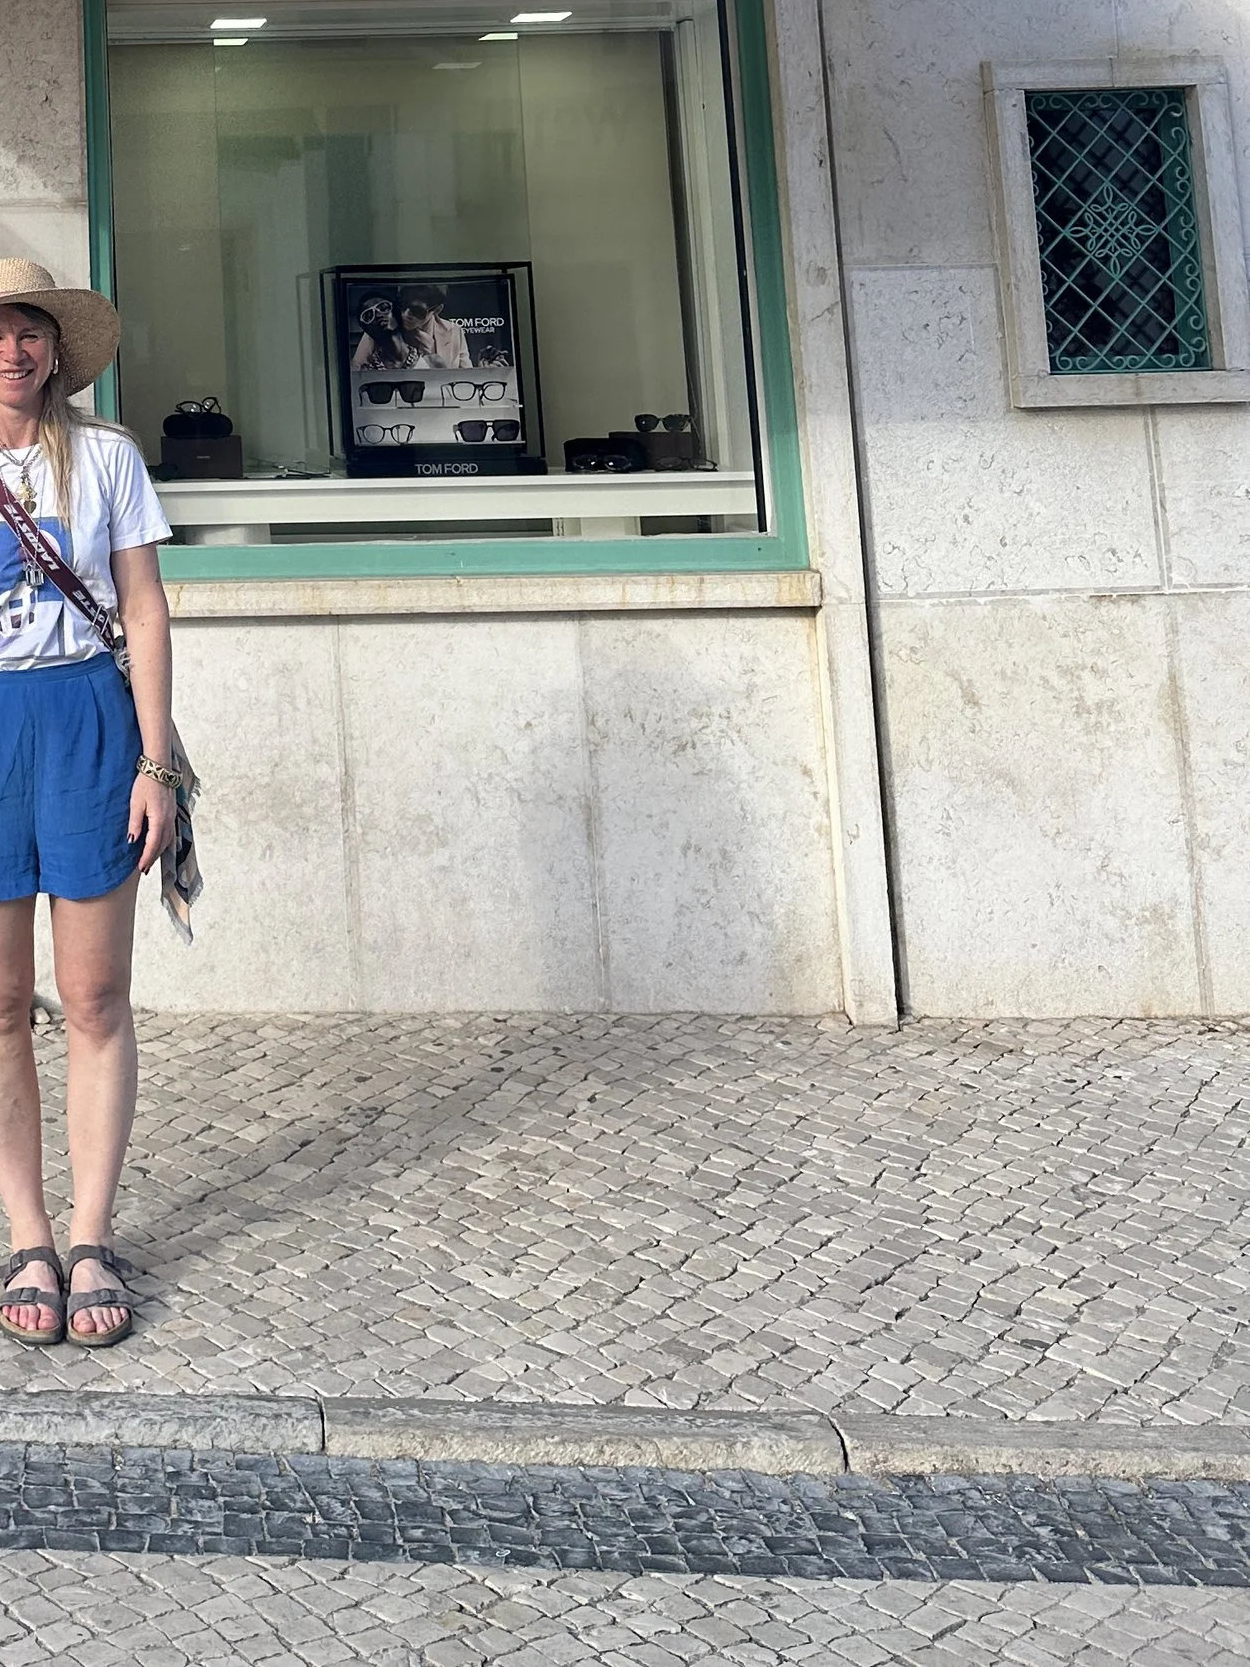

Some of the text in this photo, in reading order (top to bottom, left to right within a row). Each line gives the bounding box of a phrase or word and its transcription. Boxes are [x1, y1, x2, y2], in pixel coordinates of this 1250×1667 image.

[449, 317, 505, 327] TOM FORD
[414, 463, 479, 474] TOM FORD
